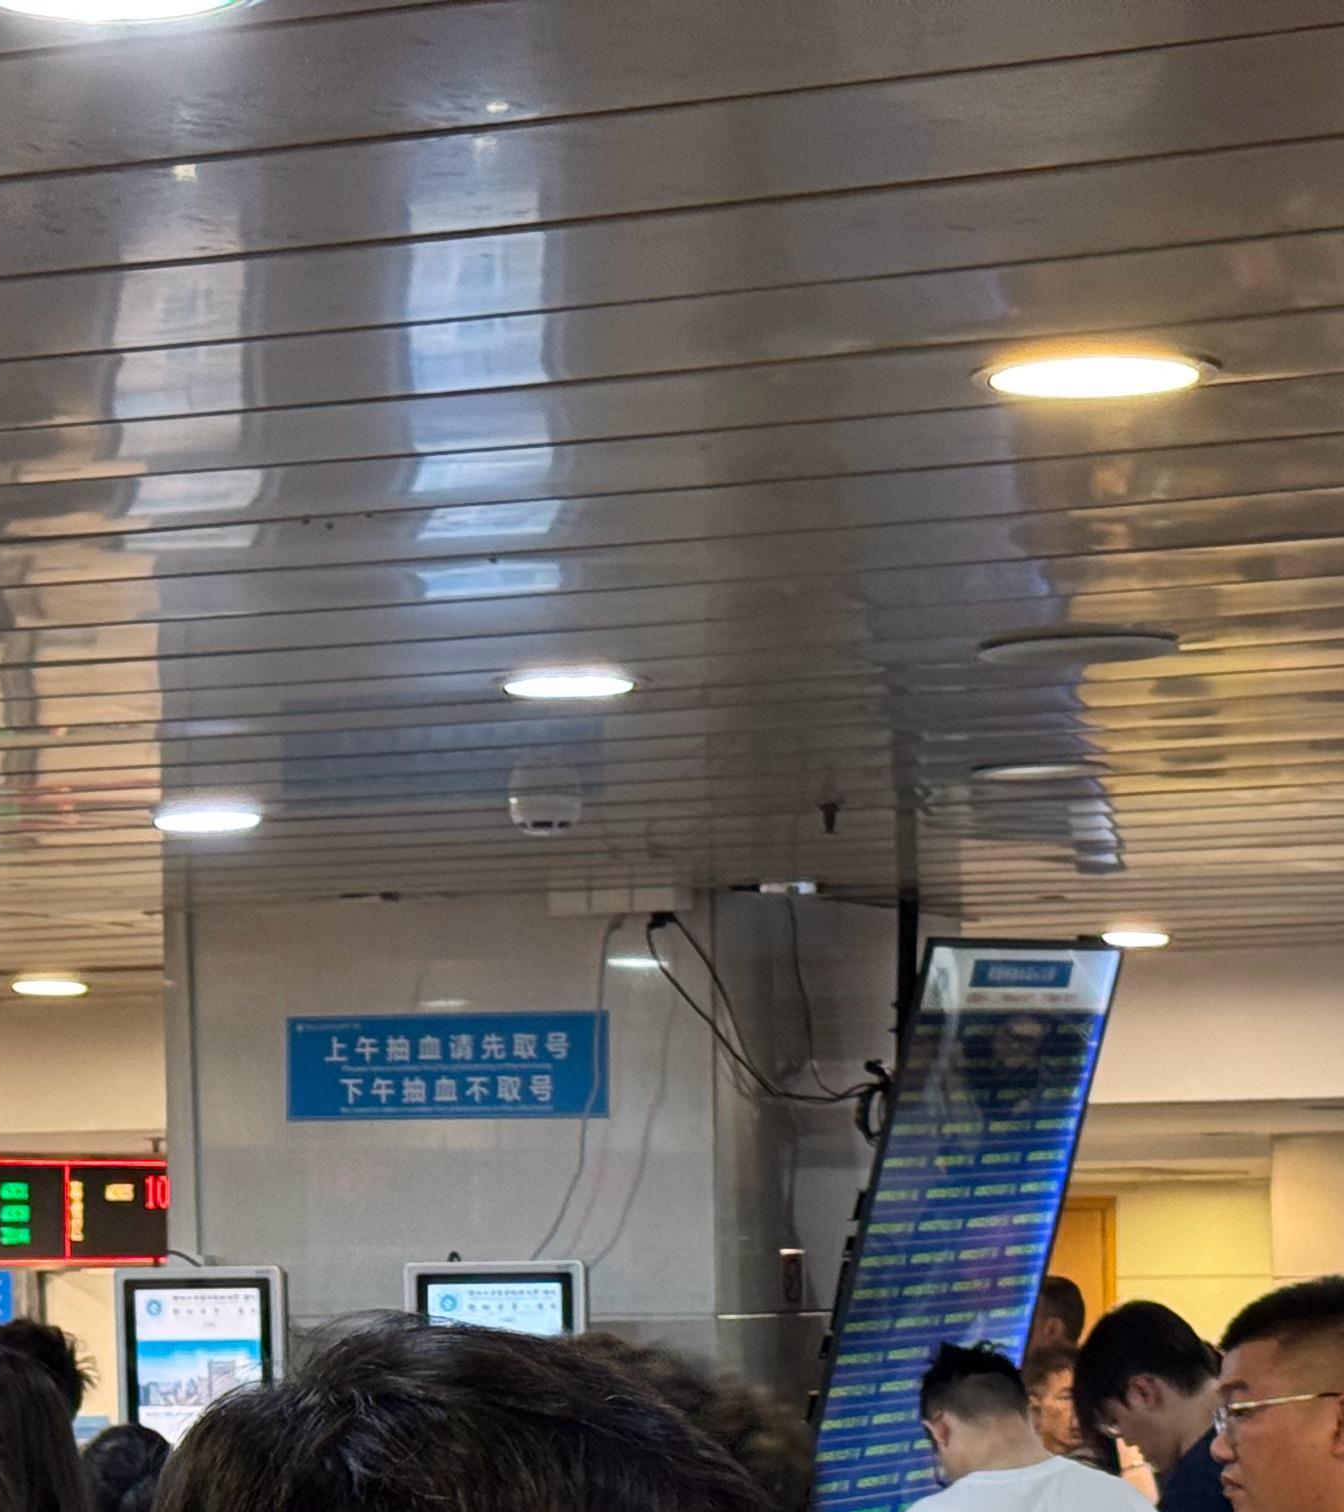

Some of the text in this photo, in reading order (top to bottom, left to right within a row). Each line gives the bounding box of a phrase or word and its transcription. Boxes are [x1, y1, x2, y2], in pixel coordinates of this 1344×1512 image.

[324, 1031, 571, 1064] 上午抽血请先取号
[339, 1073, 554, 1105] 下午抽血不取号
